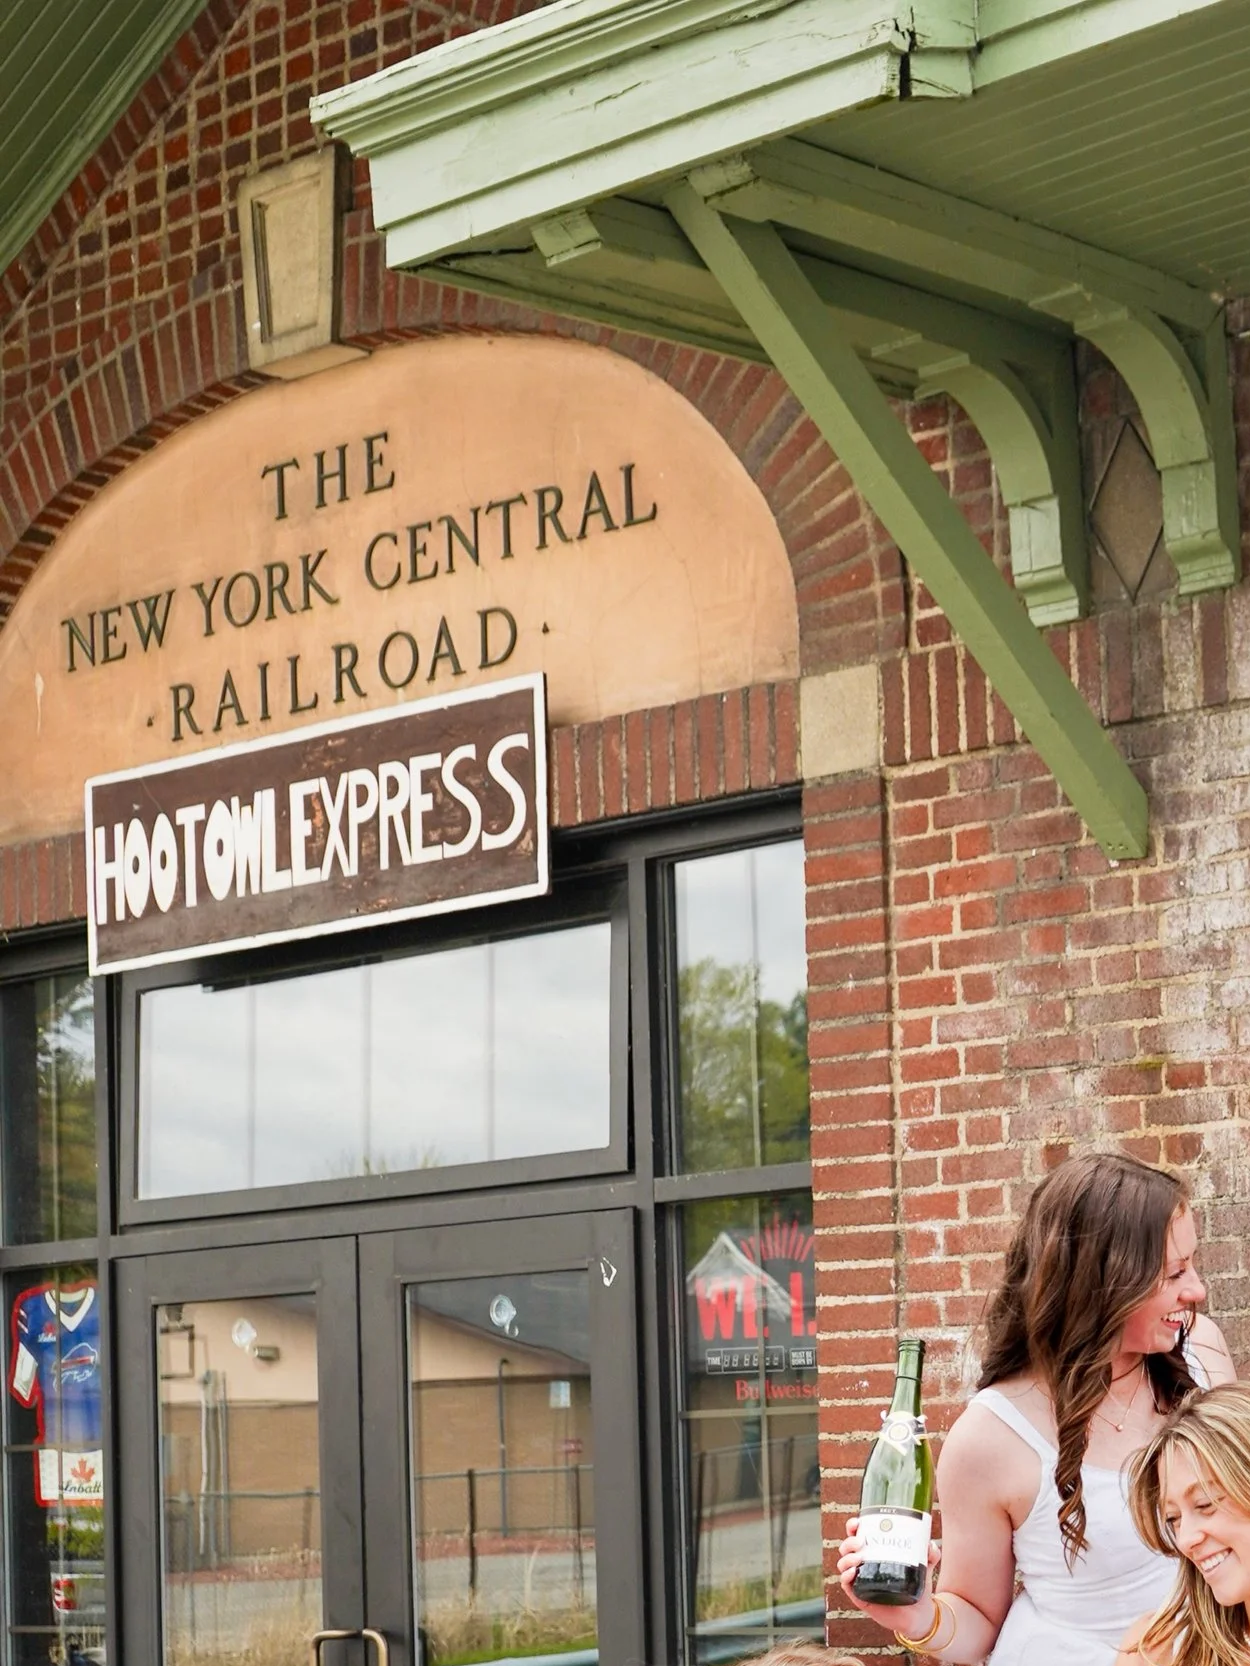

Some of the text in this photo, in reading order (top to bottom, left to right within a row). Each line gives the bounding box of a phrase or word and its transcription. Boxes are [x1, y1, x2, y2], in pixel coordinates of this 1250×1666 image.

[262, 431, 396, 521] THE
[61, 463, 658, 673] NEW YORK CENTRAL
[170, 606, 518, 742] RAILROAD
[707, 1356, 721, 1366] TIME
